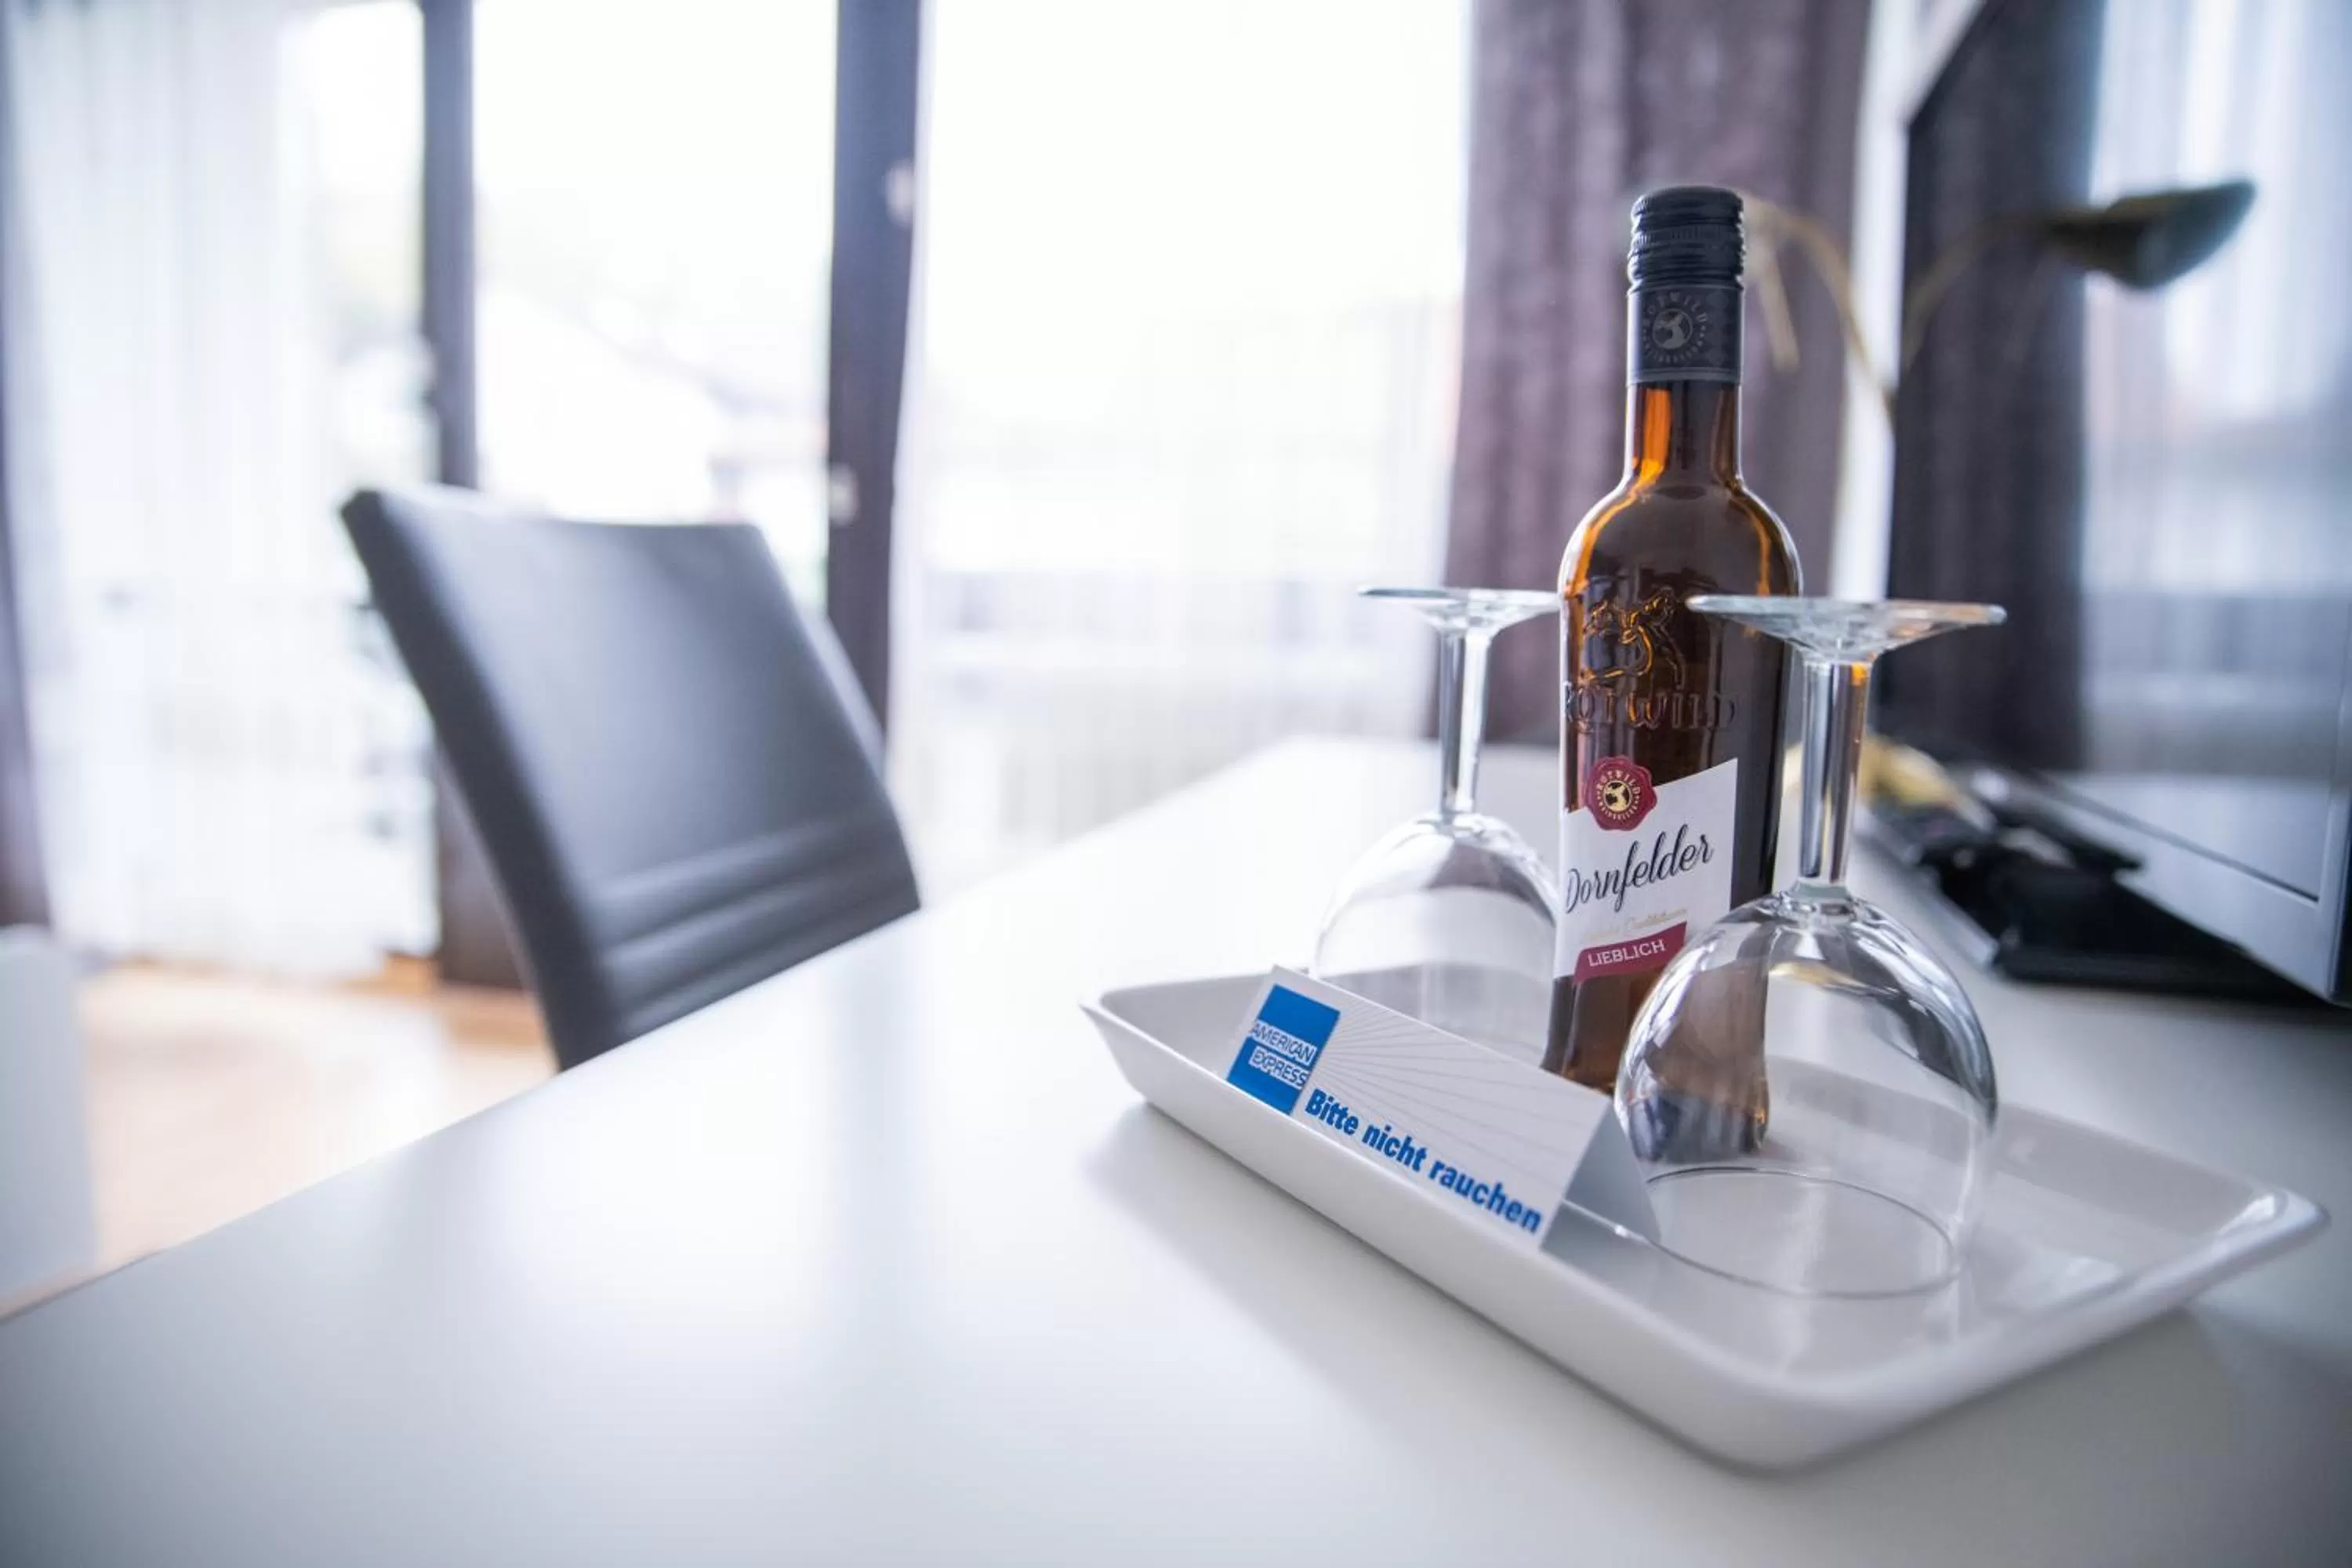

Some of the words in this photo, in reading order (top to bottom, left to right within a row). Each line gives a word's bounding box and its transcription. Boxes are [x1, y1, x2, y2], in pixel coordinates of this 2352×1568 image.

[1566, 824, 1714, 914] Dornfelder
[1588, 938, 1667, 967] LIEBLICH
[1250, 1022, 1316, 1063] AMERICAN
[1250, 1048, 1308, 1087] EXPRESS
[1305, 1088, 1359, 1136] Bitte
[1361, 1126, 1428, 1173] nicht
[1427, 1160, 1543, 1235] rauchen
